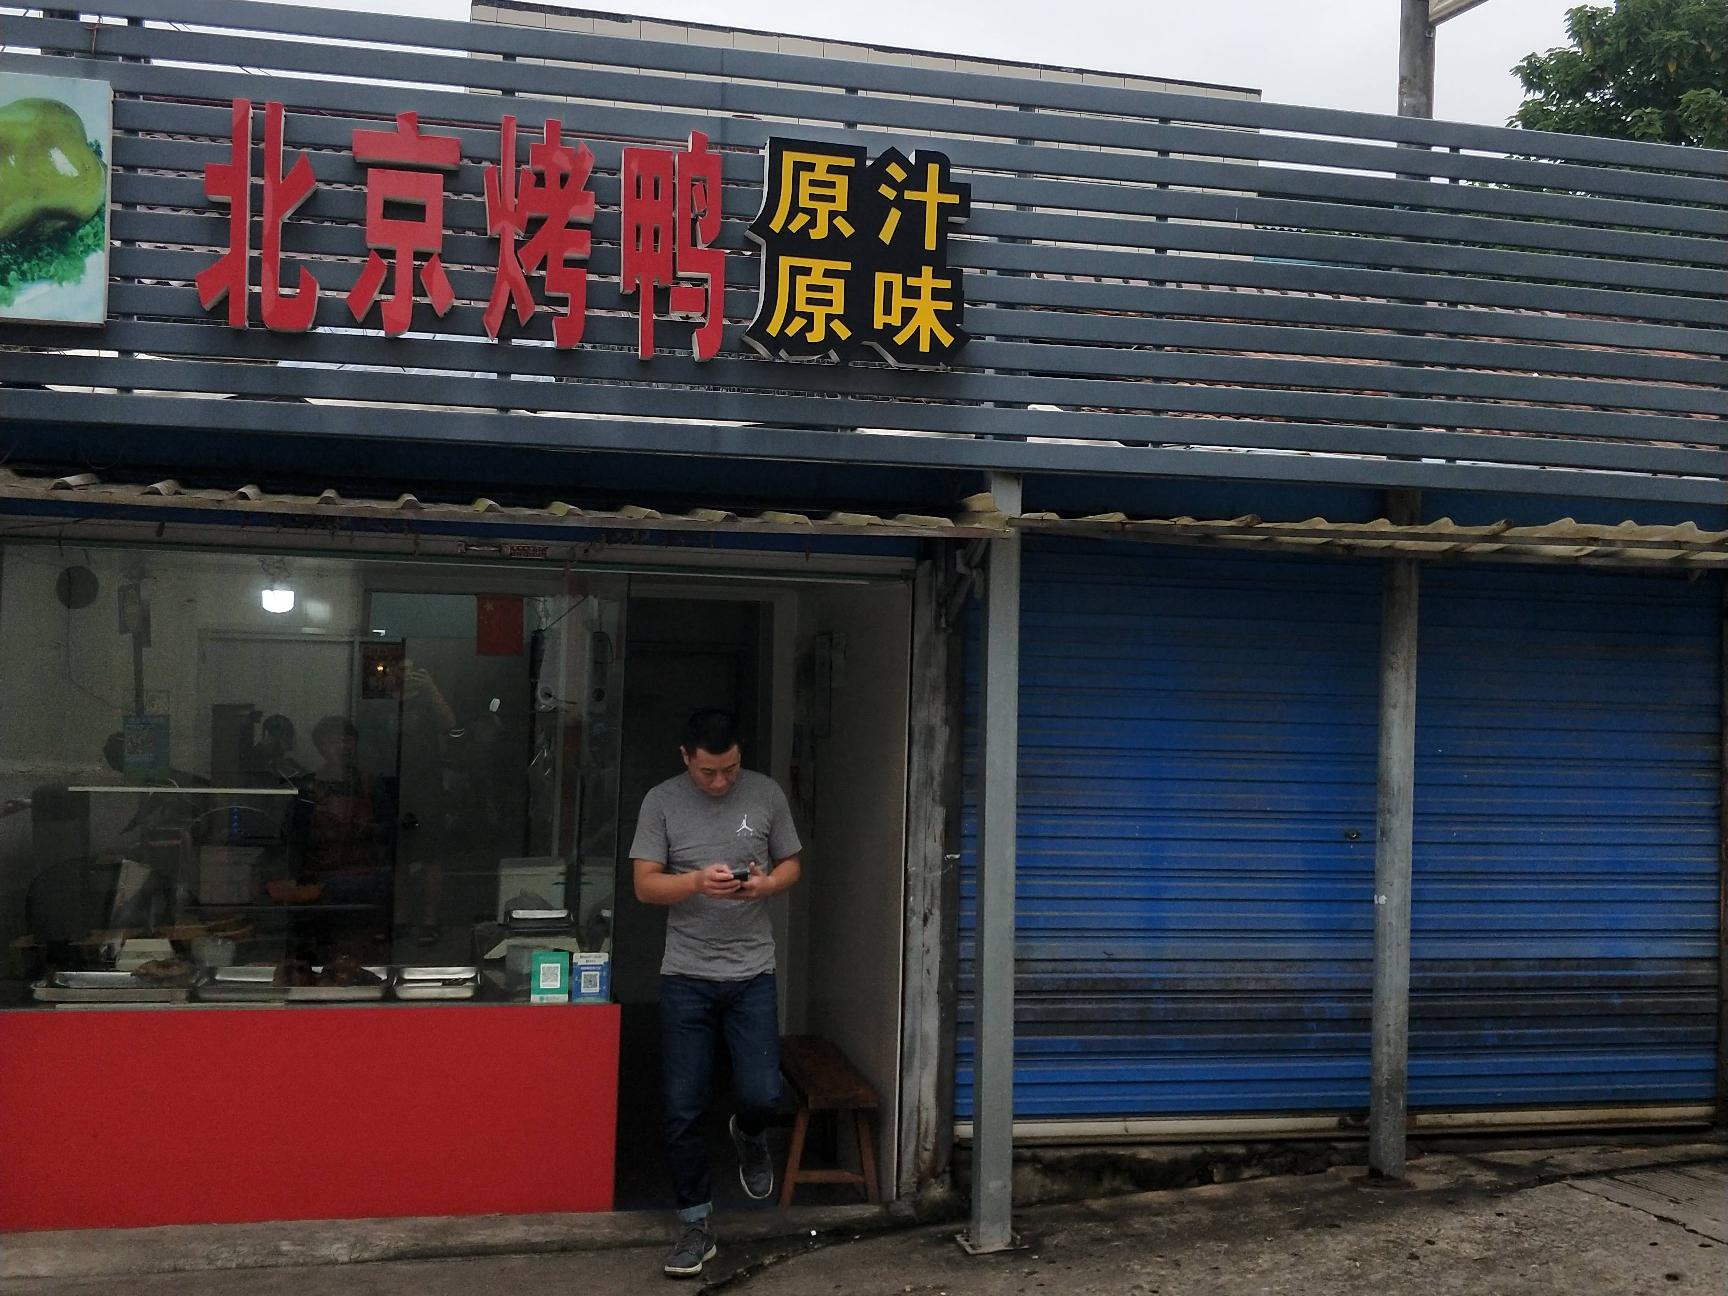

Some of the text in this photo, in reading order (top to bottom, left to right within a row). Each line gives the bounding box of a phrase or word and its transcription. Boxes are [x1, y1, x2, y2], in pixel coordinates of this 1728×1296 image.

[195, 98, 727, 362] 北京烤鸭
[768, 150, 960, 251] 原汁
[765, 255, 955, 353] 原味
